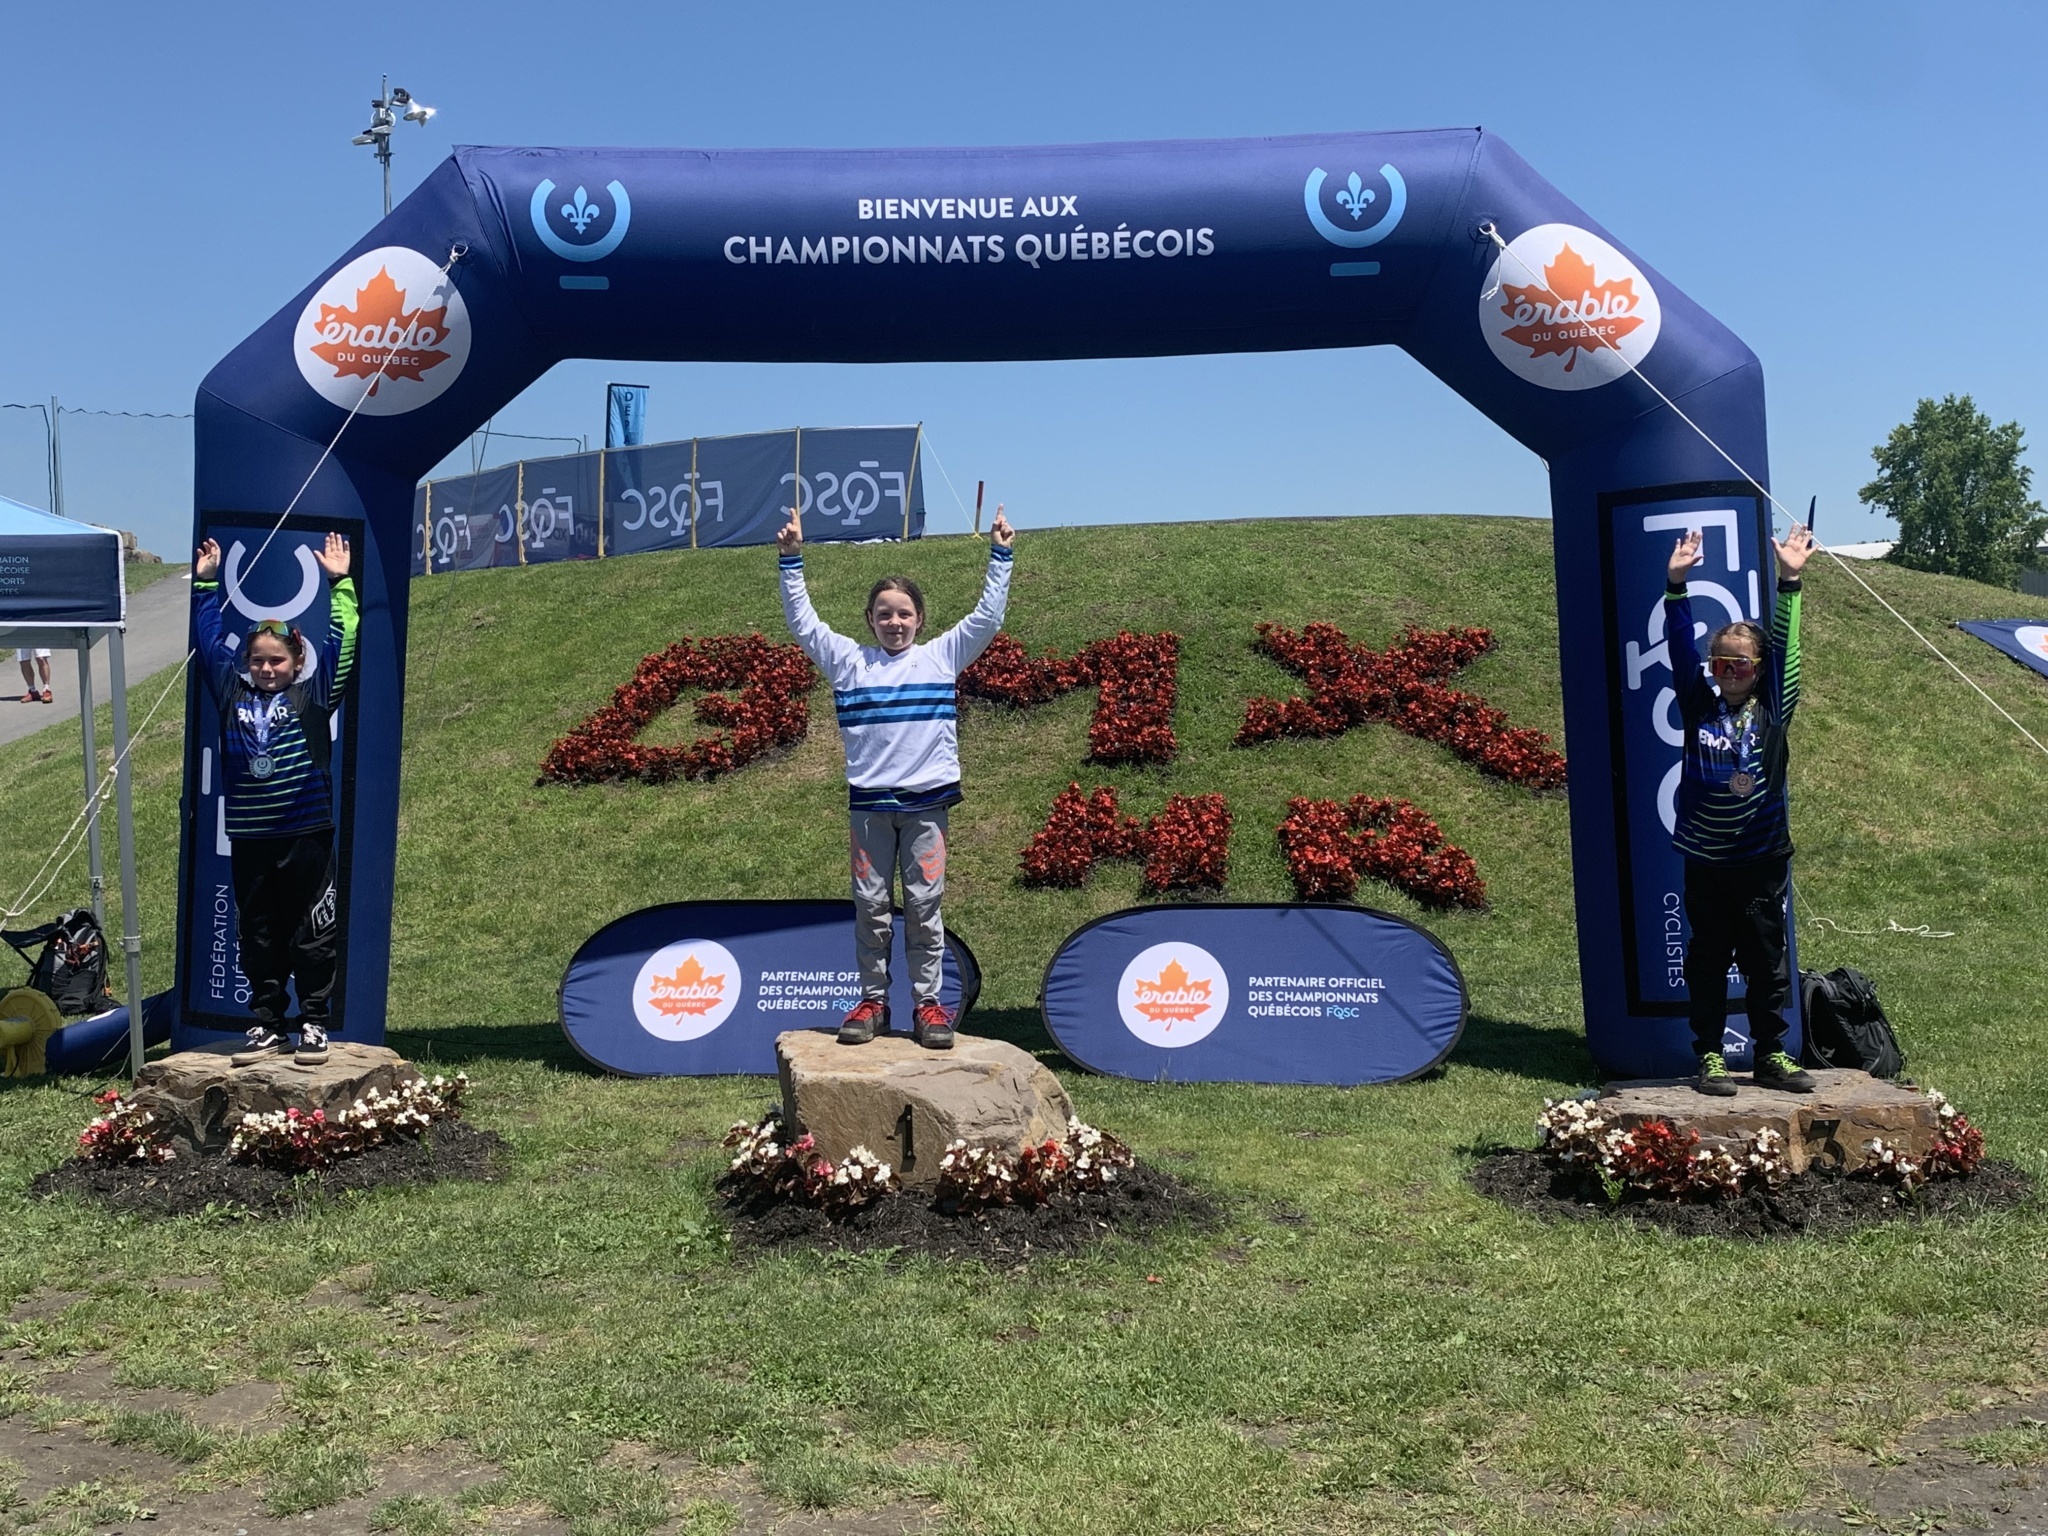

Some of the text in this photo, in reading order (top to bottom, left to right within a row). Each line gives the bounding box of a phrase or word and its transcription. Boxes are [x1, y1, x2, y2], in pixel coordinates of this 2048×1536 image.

[858, 196, 1078, 220] BIENVENUE AUX
[723, 223, 1215, 269] CHAMPIONNATS QUÉBÉCOIS
[1513, 290, 1629, 327] érable
[322, 313, 438, 351] érable
[1532, 325, 1616, 343] DU QUÉBEC
[337, 352, 420, 366] DU QUÉBEC
[211, 884, 229, 999] FÉDÉRATION
[1663, 892, 1685, 988] CYCLISTES
[761, 971, 835, 982] PARTENAIRE
[1249, 976, 1386, 989] PARTENAIRE OFFICIEL
[655, 981, 719, 999] érable
[759, 985, 783, 996] DES
[1141, 985, 1205, 1005] érable
[1249, 991, 1379, 1004] DES CHAMPIONNATS
[675, 1000, 707, 1008] QUÉBEC
[757, 997, 828, 1012] QUÉBÉCOIS
[1163, 1005, 1195, 1013] QUÉBEC
[1247, 1003, 1360, 1020] QUÉBÉCOIS FQSC
[203, 1086, 231, 1147] 2
[896, 1104, 915, 1161] 1
[1807, 1118, 1845, 1175] 3
